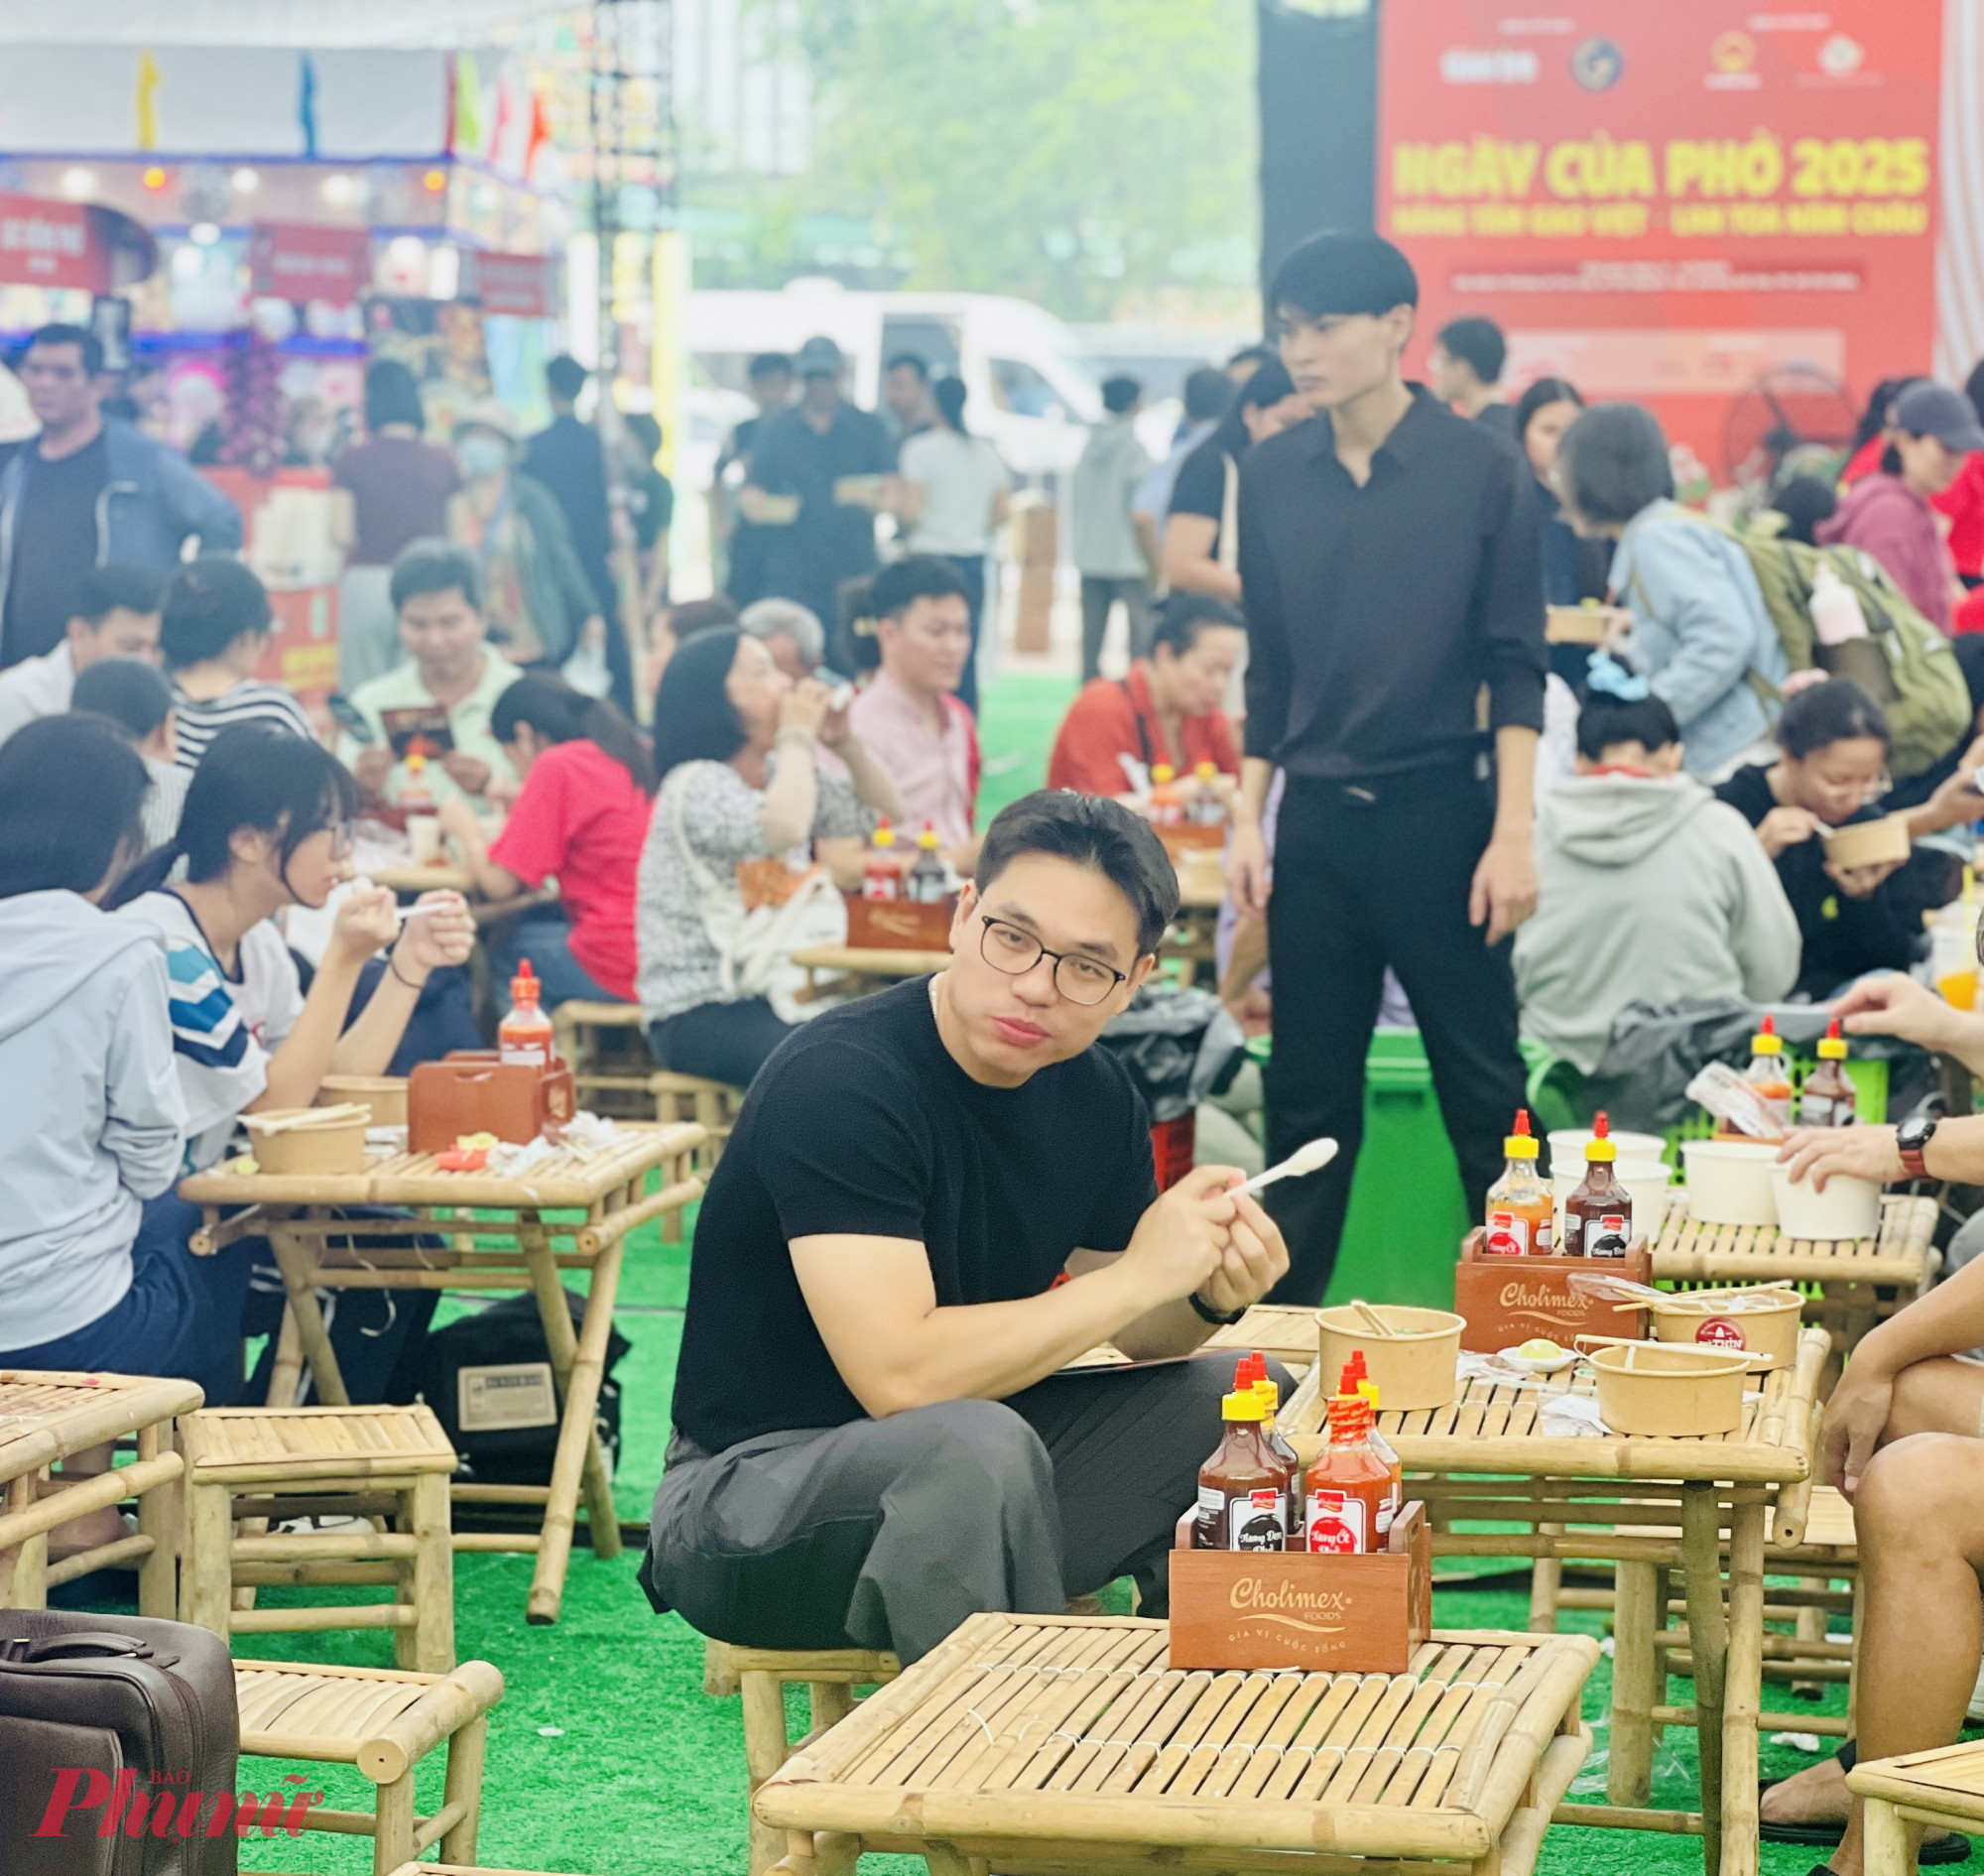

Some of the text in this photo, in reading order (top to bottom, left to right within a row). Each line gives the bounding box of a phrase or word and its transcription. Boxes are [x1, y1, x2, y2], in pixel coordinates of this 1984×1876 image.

[1395, 126, 1929, 197] NGÀY CỦA PHỞ 2025
[1499, 1282, 1588, 1310] Cholimex
[1230, 1577, 1345, 1611] Cholimex
[1303, 1611, 1341, 1621] FOODS
